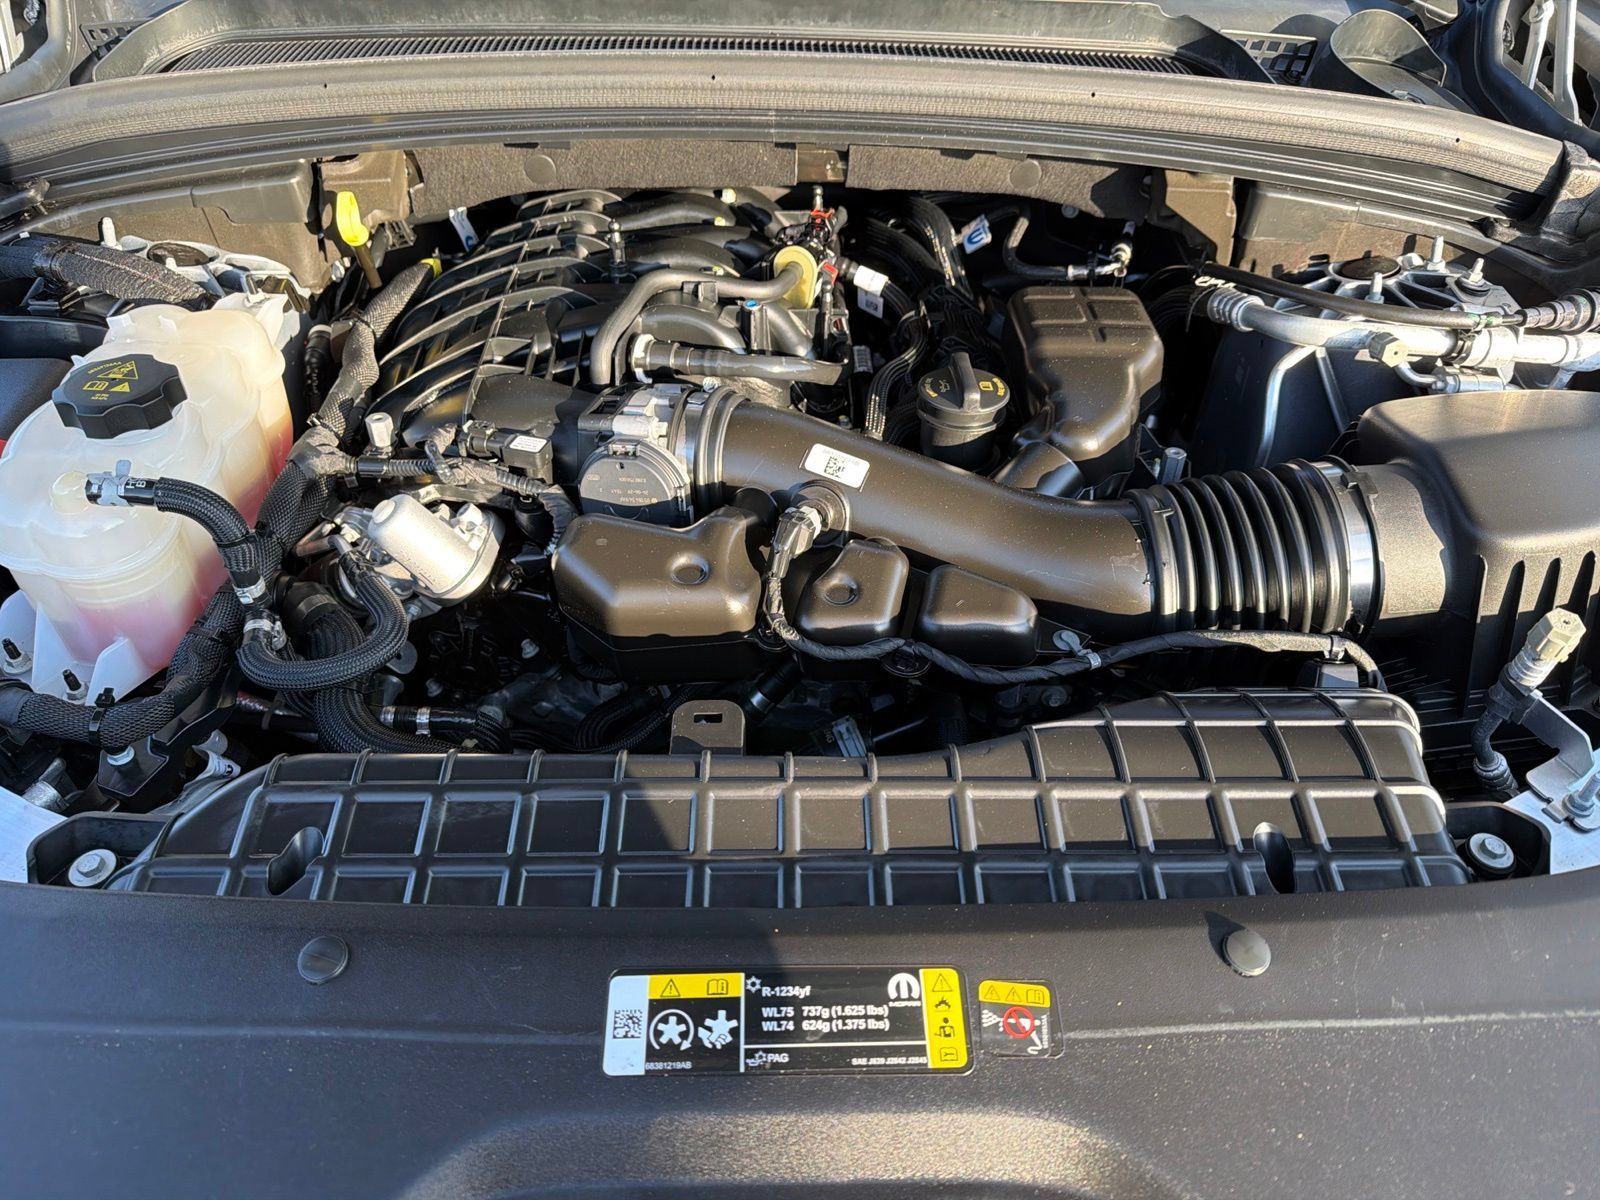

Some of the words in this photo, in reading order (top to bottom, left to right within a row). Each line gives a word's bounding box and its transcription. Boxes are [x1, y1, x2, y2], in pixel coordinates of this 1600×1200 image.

[761, 985, 812, 999] R-1234yf
[761, 1007, 794, 1017] WL75
[801, 1006, 830, 1018] 737g
[831, 1005, 866, 1018] (1.625
[866, 1004, 889, 1017] lbs)
[761, 1021, 794, 1031] WL74
[802, 1020, 831, 1033] 624g
[831, 1019, 867, 1032] (1.375
[867, 1018, 890, 1031] lbs)
[767, 1053, 789, 1062] PAG
